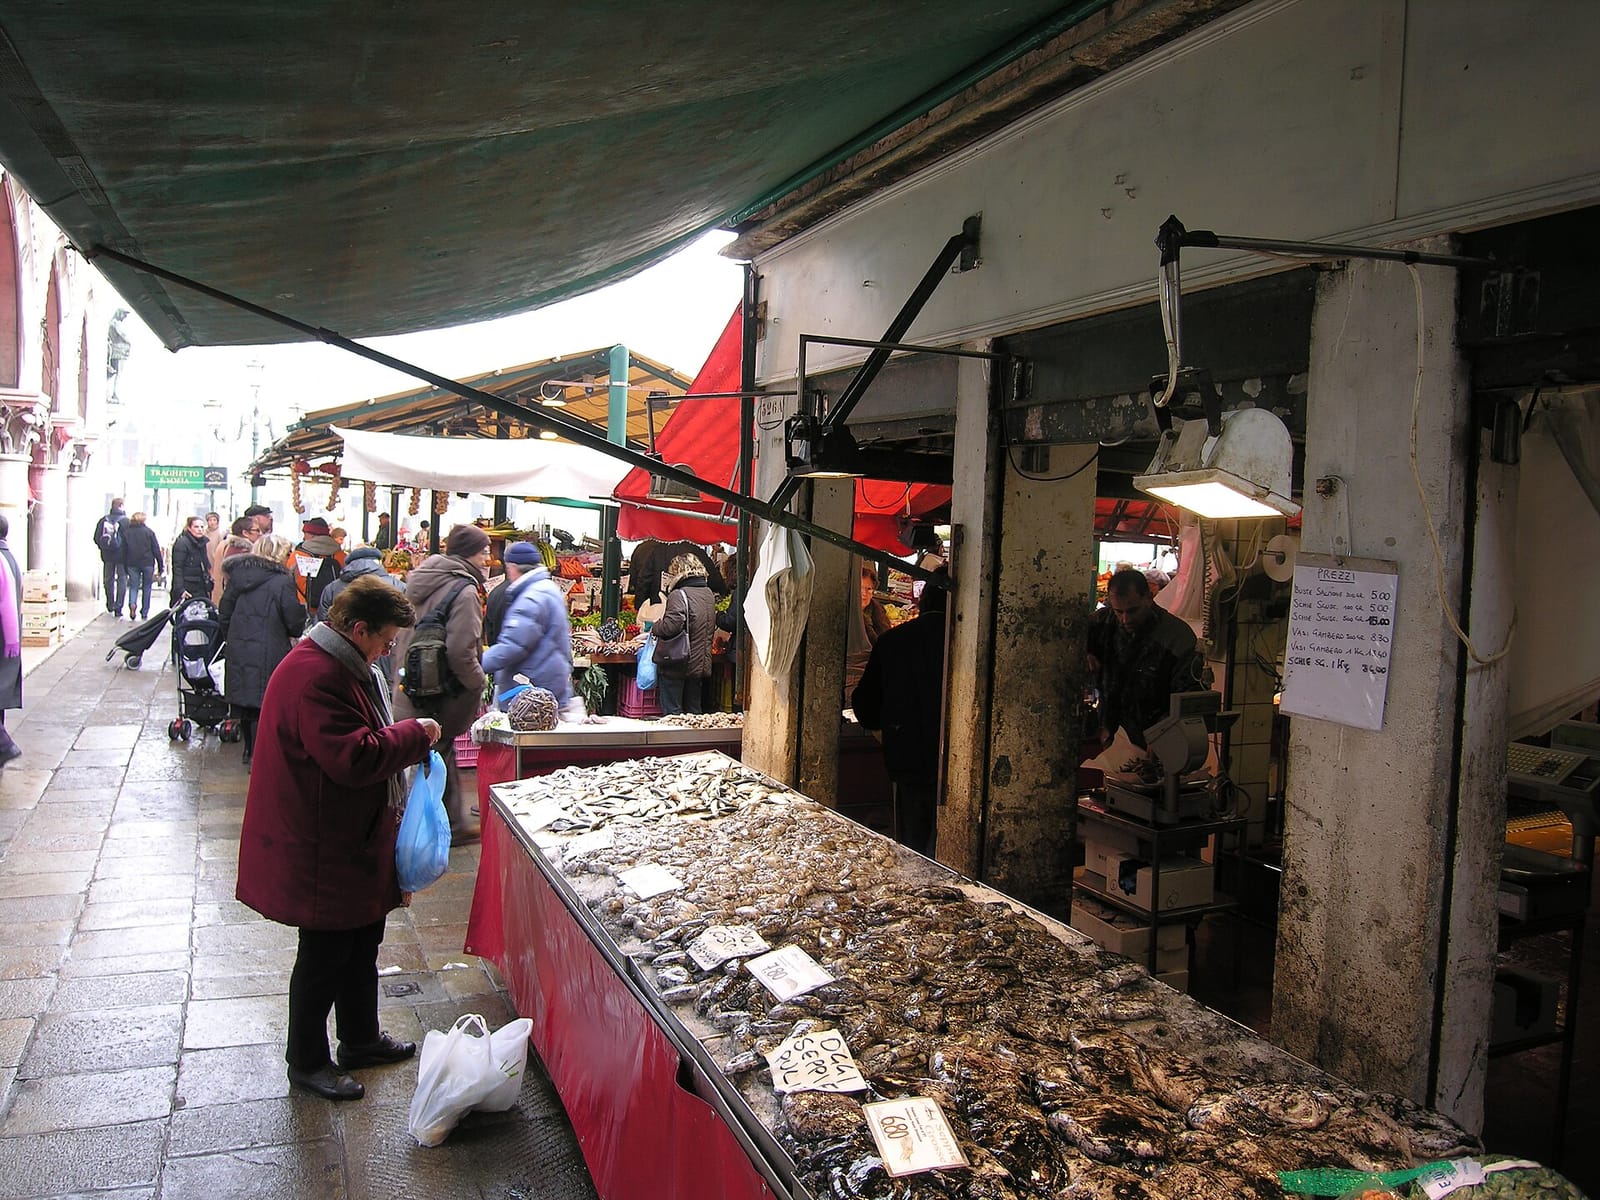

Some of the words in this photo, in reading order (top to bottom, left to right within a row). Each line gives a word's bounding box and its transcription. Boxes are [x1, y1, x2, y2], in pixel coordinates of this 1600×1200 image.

[150, 469, 200, 478] TRAGHETTO
[1318, 568, 1355, 580] PREZZI
[1312, 629, 1344, 640] GAMBERO
[1309, 643, 1343, 654] GAMBERO
[1287, 656, 1311, 666] SCHIE
[820, 1038, 858, 1085] OGGI
